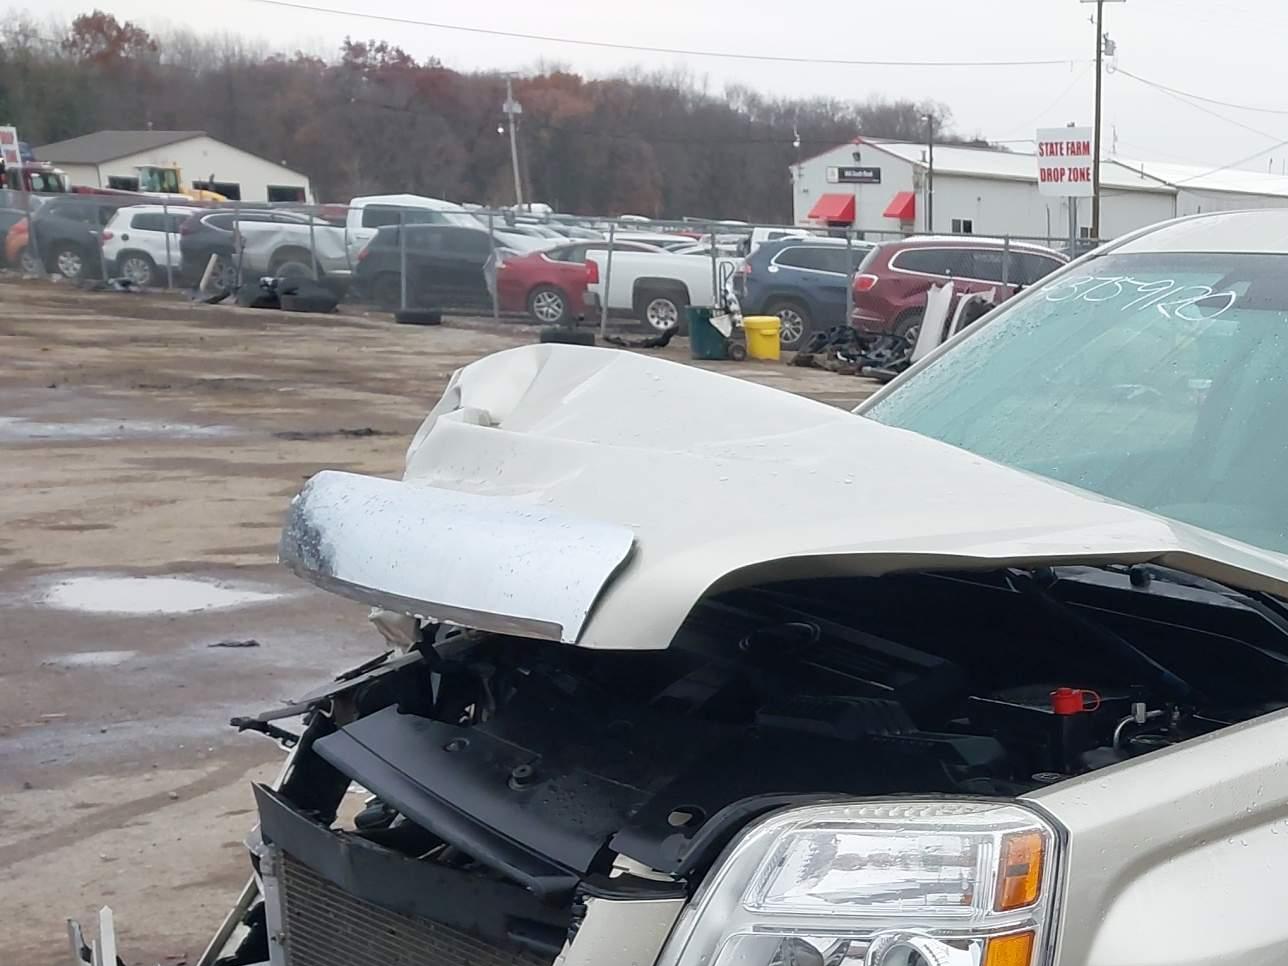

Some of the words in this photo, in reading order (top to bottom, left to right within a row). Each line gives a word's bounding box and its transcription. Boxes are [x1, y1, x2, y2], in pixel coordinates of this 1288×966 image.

[1038, 141, 1064, 157] STATE
[1066, 140, 1090, 156] FARM
[1040, 167, 1065, 183] DROP
[1068, 166, 1091, 182] ZONE
